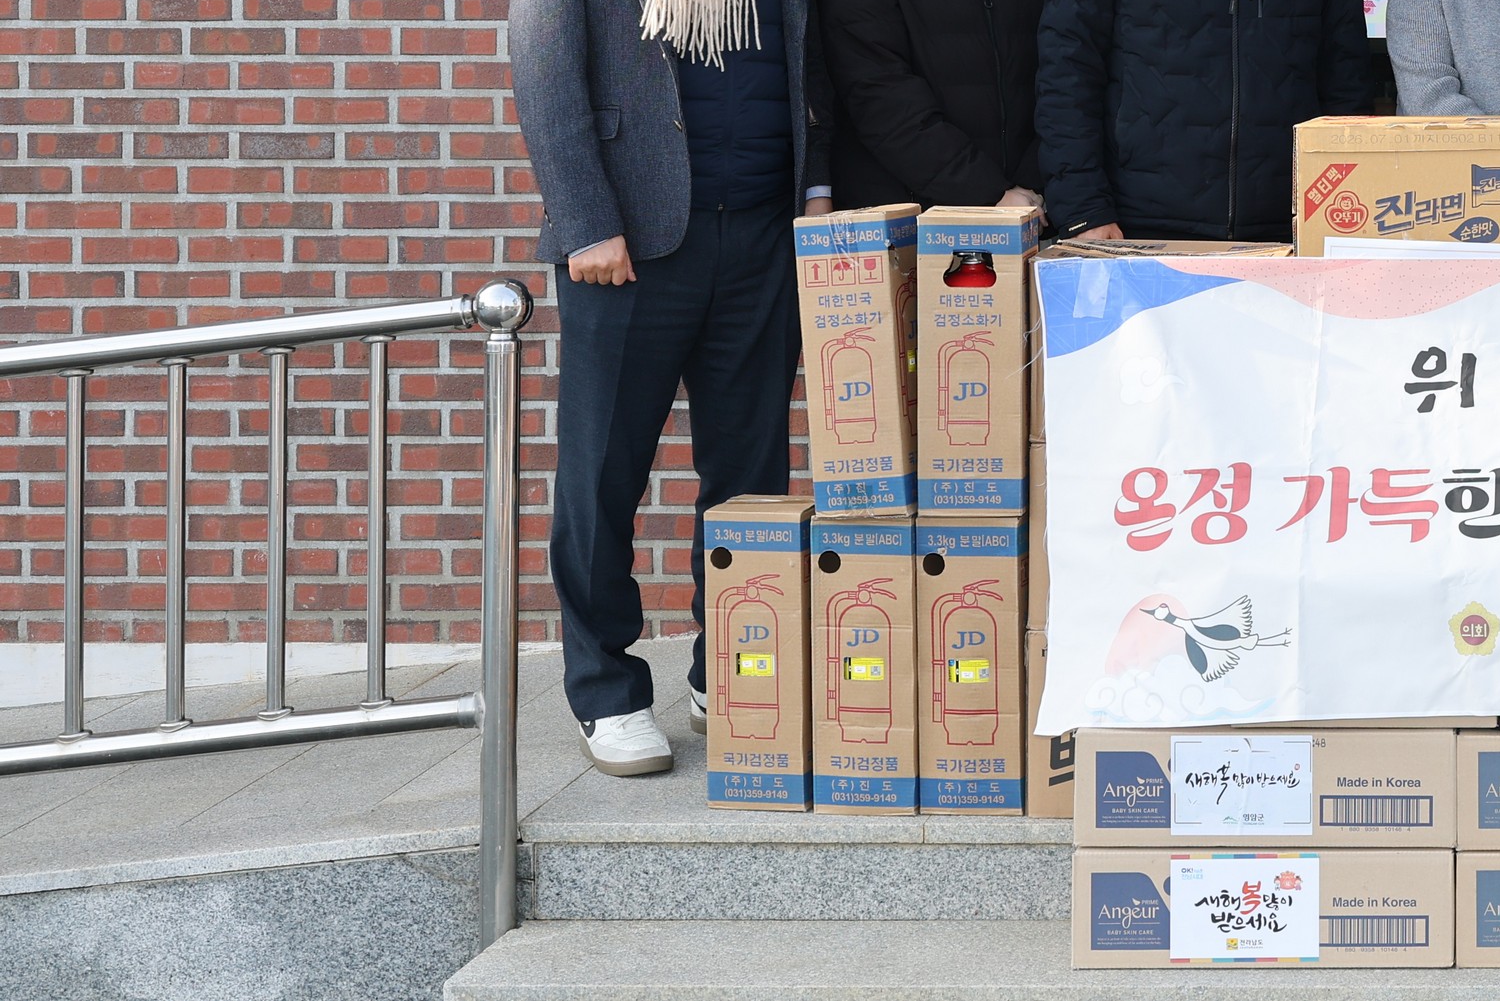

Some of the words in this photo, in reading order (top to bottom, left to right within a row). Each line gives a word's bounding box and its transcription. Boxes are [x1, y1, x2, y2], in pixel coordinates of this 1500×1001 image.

[1307, 166, 1344, 204] 멀티팩
[1332, 211, 1362, 224] 오뚜기
[1374, 191, 1466, 236] 진라면
[926, 233, 955, 246] 3.3kg
[1460, 222, 1494, 241] 순한맛
[818, 292, 872, 308] 대한민국
[939, 294, 994, 308] 대한민국
[814, 311, 882, 329] 검정소화기
[934, 313, 1002, 327] 검정소화기
[1403, 345, 1476, 415] 위
[838, 381, 871, 402] JD
[953, 382, 988, 401] JD
[823, 457, 893, 473] 국가검정품
[932, 457, 1004, 472] 국가검정품
[827, 493, 894, 507] (031)359-9149
[934, 494, 1002, 506] (031)359-9149
[1112, 462, 1254, 553] 온정
[714, 529, 742, 543] 3.3kg
[928, 534, 956, 549] 3.3kg
[738, 625, 770, 644] JD
[847, 628, 880, 647] JD
[1461, 625, 1489, 638] 의회
[952, 631, 986, 649] JD
[723, 752, 789, 768] 국가검정품
[830, 755, 898, 772] 국가검정품
[936, 758, 1006, 774] 국가검정품
[1185, 772, 1217, 787] 새해
[1233, 773, 1254, 788] 많이
[1256, 771, 1300, 788] 받으세요
[1337, 777, 1368, 787] Made
[1372, 777, 1382, 787] in
[1386, 777, 1421, 787] Korea
[724, 788, 788, 800] (031)359-9149
[831, 792, 897, 804] (031)359-9149
[938, 794, 1005, 806] (031)359-9149
[1103, 782, 1164, 807] Angeur
[1243, 814, 1264, 822] 영암군
[1194, 889, 1241, 910] 새해
[1240, 881, 1262, 915] 복
[1263, 893, 1293, 911] 많이
[1098, 902, 1160, 928] Angeur
[1211, 911, 1287, 933] 받으세요
